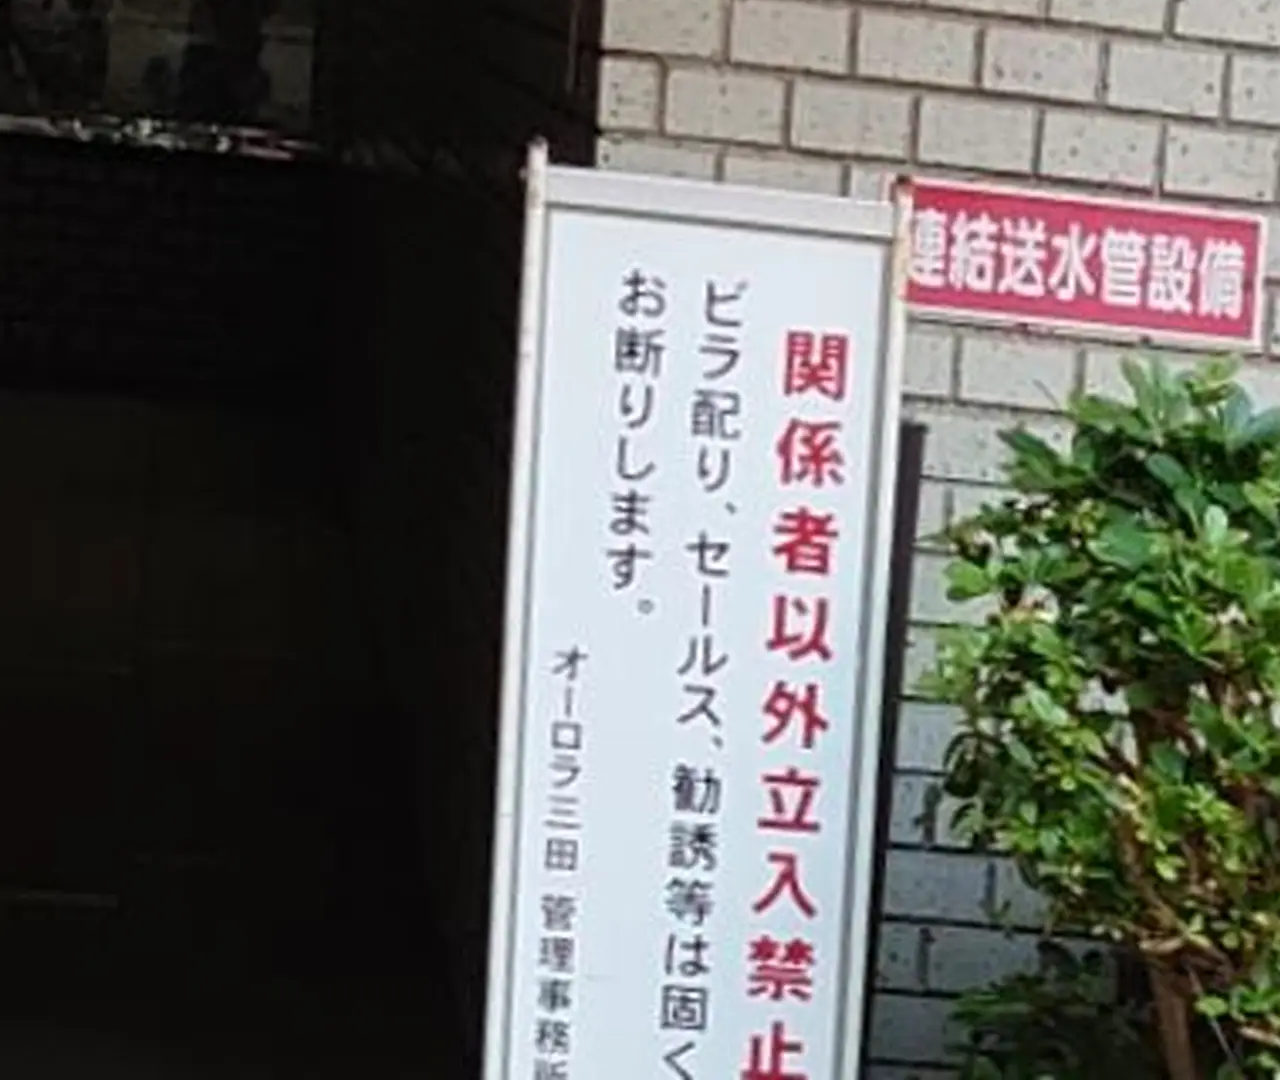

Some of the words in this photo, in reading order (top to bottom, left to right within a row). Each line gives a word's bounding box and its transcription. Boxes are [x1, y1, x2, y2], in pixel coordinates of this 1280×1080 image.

[908, 206, 1245, 320] 連結送水管設備
[608, 268, 668, 616] お断りします。
[741, 330, 848, 1080] 関係者以外立入禁止
